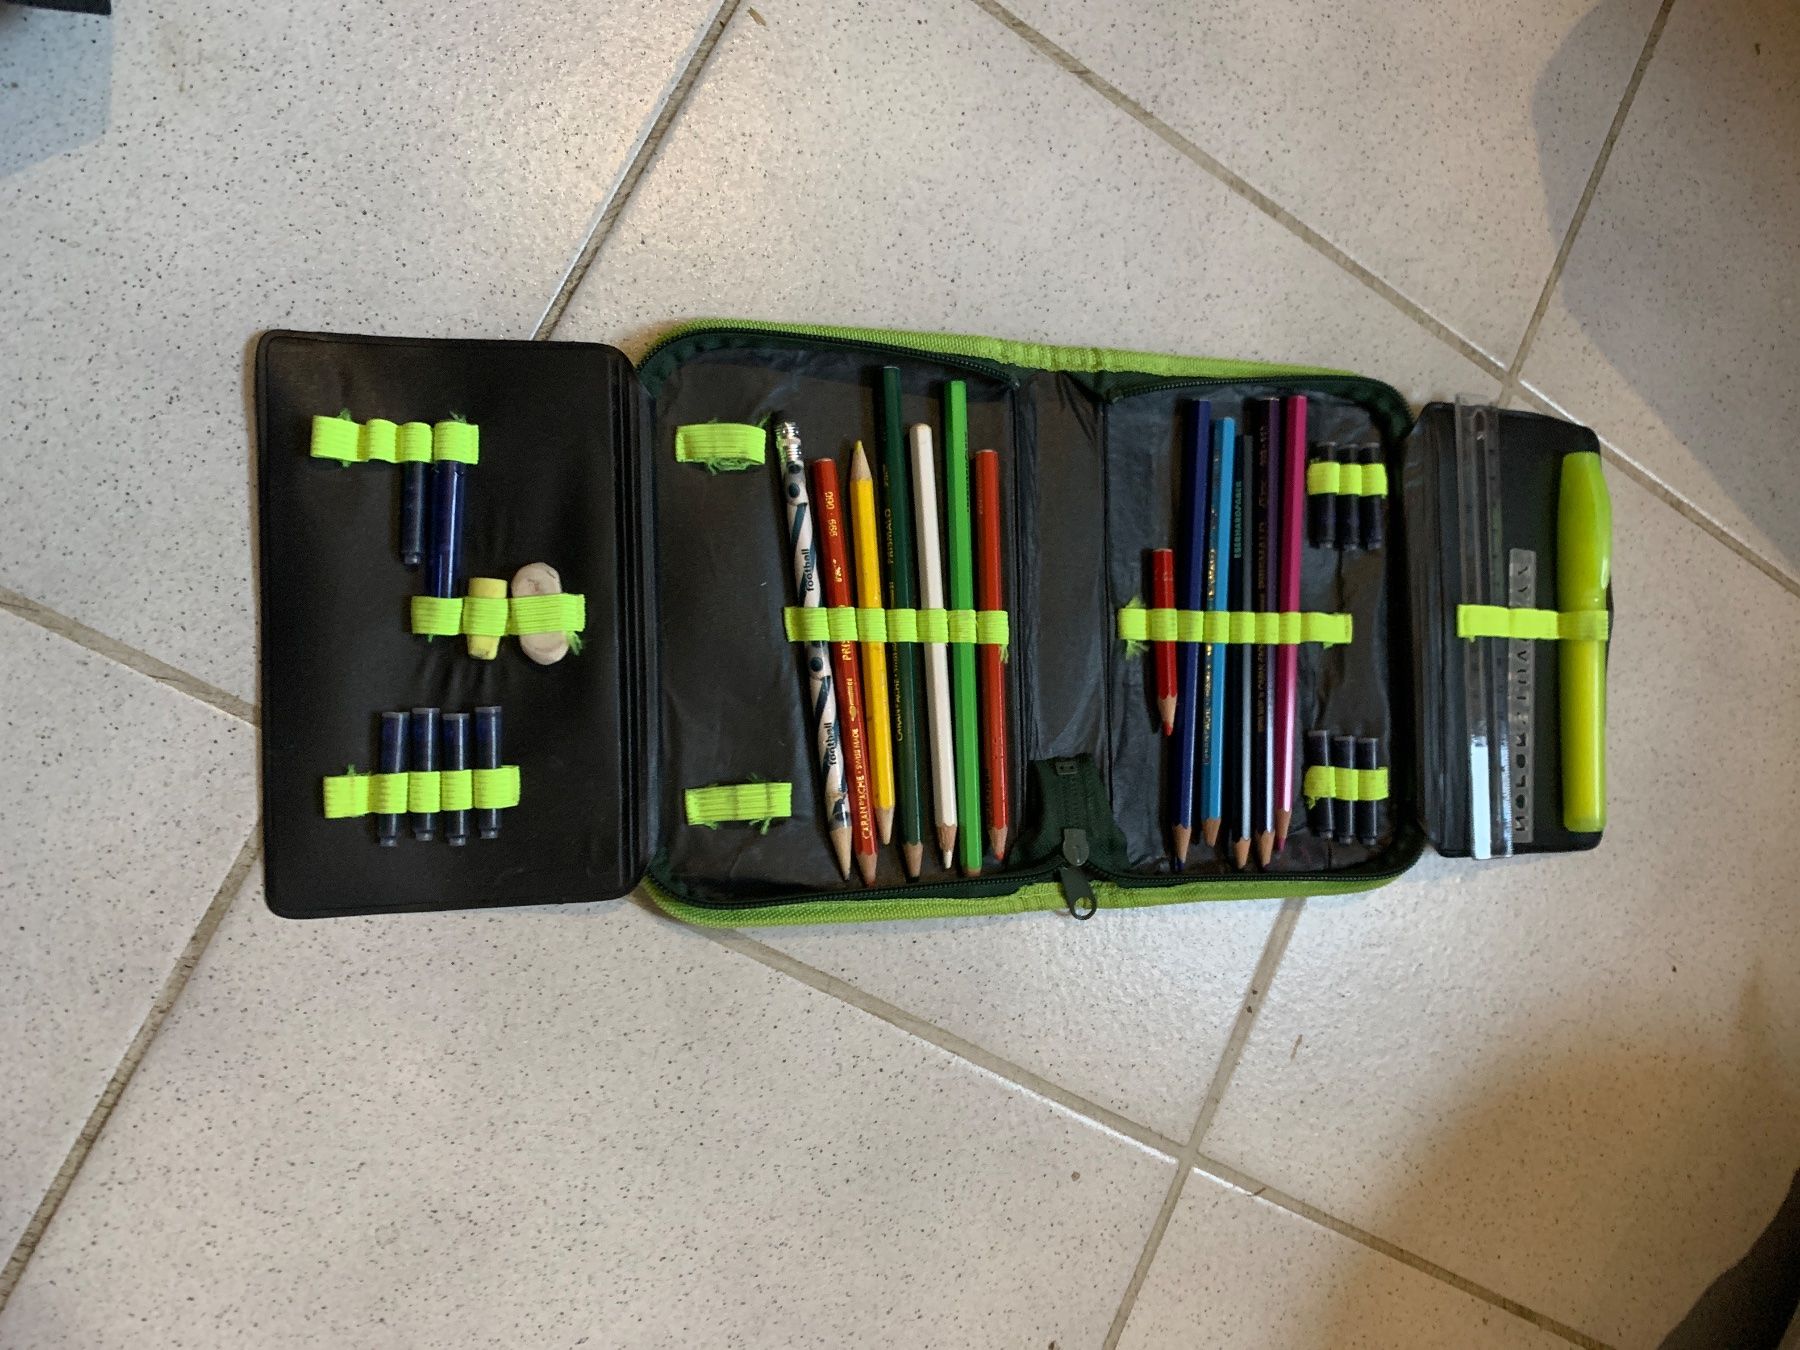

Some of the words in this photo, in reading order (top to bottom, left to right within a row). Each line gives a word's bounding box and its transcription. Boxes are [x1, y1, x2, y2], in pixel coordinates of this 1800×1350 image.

[801, 548, 815, 592] football
[823, 721, 838, 767] football
[851, 728, 861, 748] MADE
[853, 749, 863, 770] SWISS
